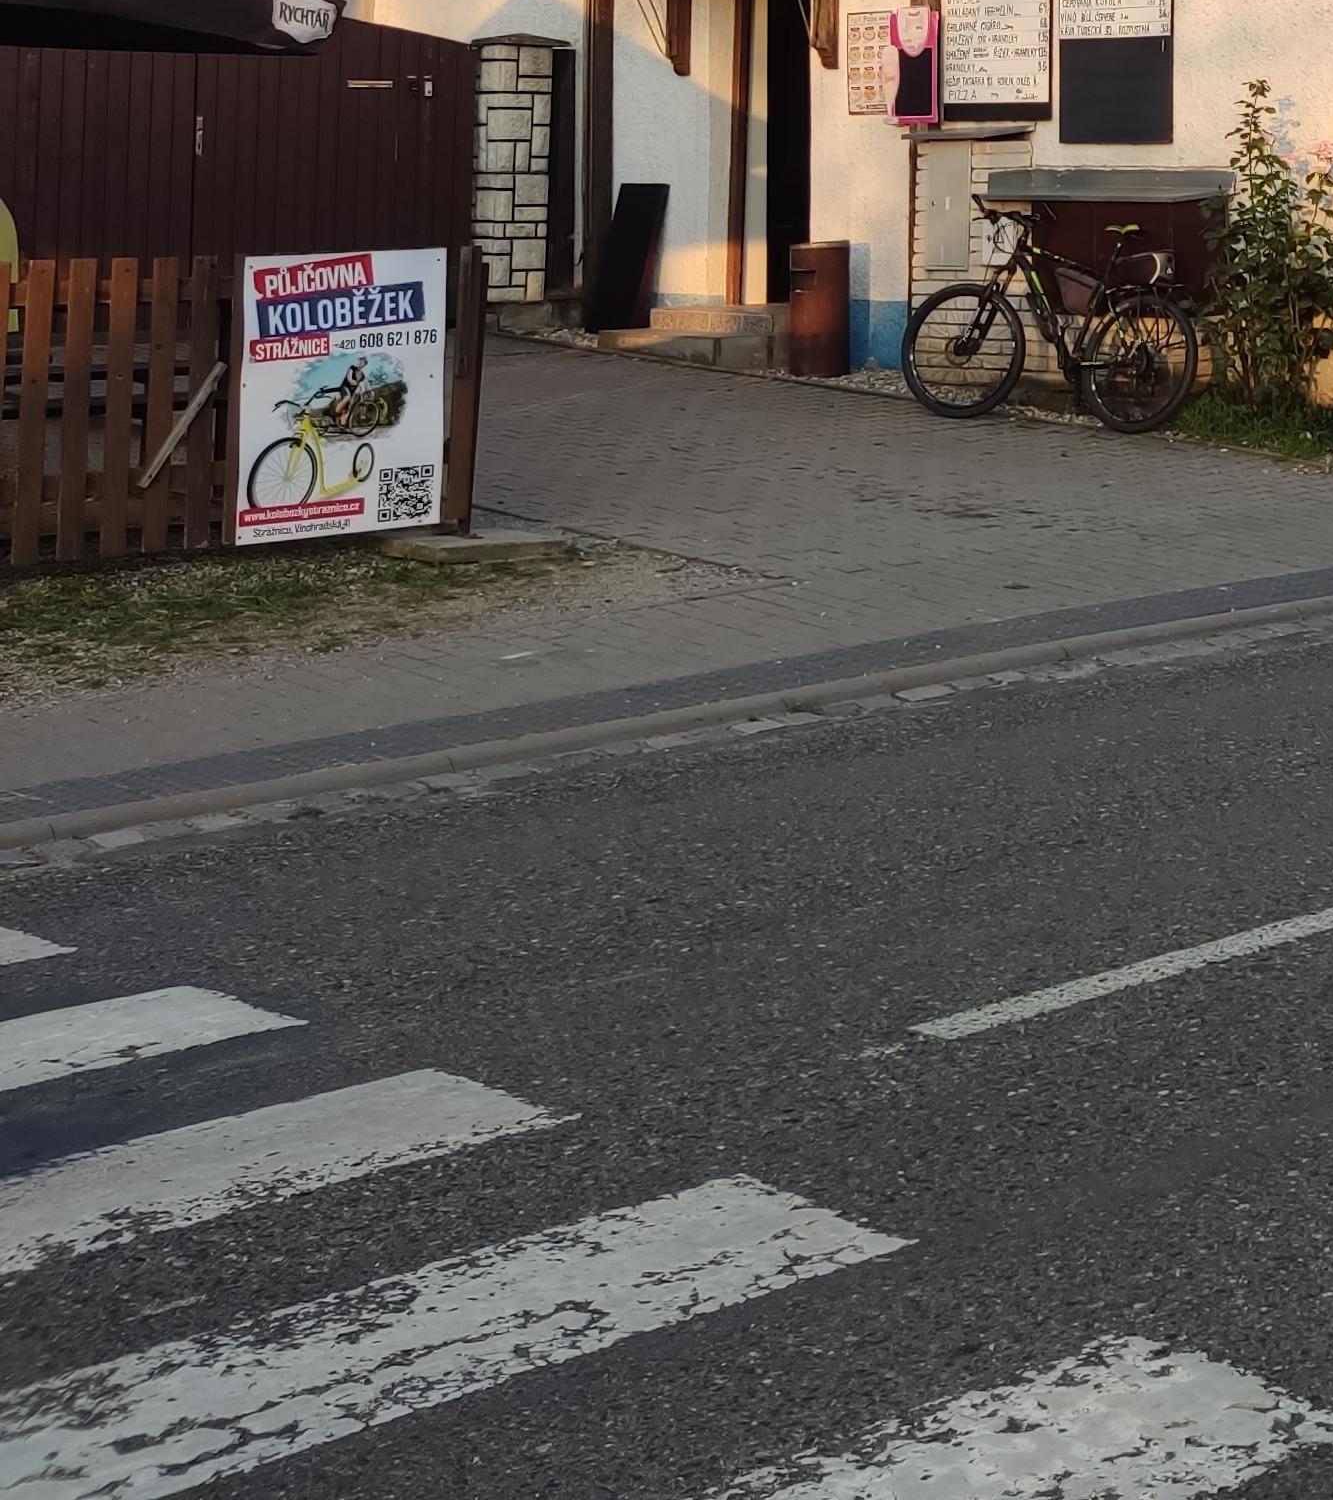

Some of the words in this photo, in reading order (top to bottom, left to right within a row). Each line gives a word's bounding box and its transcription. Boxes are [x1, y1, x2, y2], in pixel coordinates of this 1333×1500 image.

[279, 2, 330, 32] RYCHTÁŘ
[948, 89, 977, 101] PIZZA
[264, 262, 367, 299] PŮJČOVNA
[268, 287, 415, 336] KOLOBĚŽEK
[255, 337, 329, 361] STRÁŽNICE
[359, 333, 384, 348] 608
[387, 331, 411, 346] 621
[414, 328, 438, 344] 876
